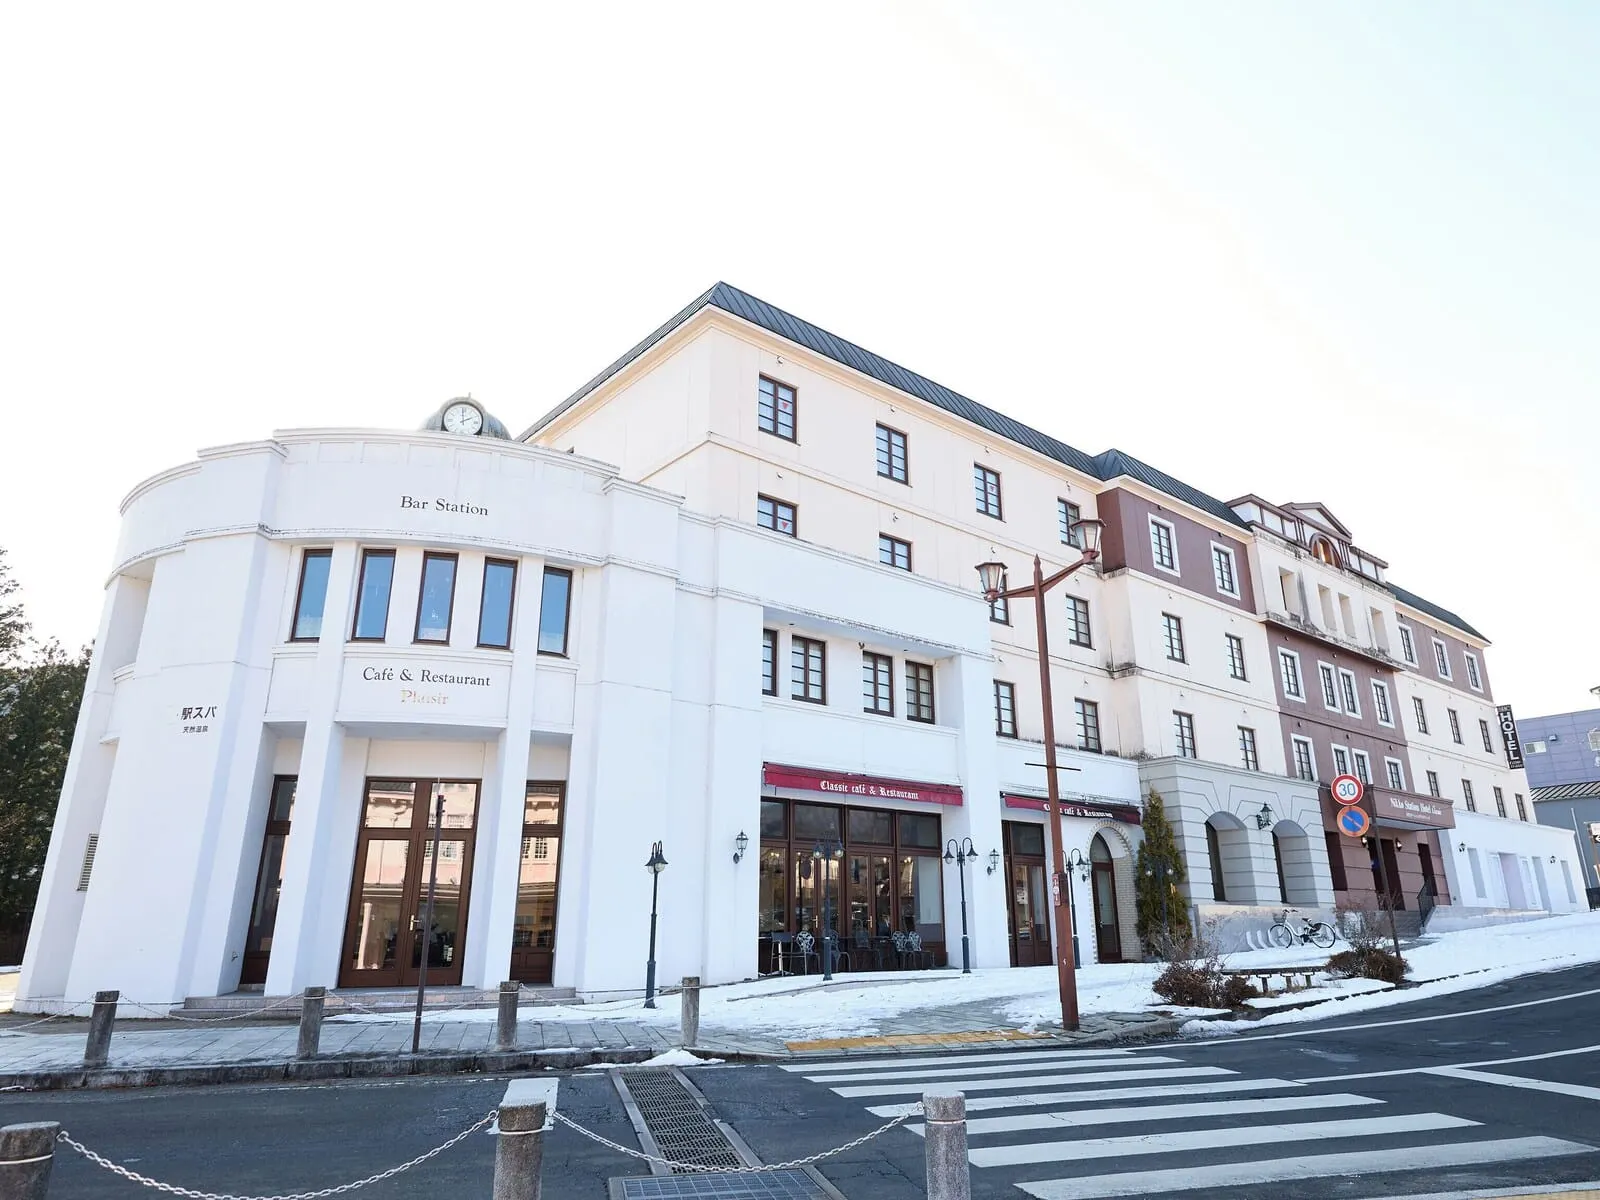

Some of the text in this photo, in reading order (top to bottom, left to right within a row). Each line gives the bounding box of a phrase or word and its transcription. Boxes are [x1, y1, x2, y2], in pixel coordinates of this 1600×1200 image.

[400, 496, 488, 516] Bar Station
[363, 667, 491, 686] Café & Restaurant
[180, 706, 217, 720] 駅スパ
[1500, 712, 1519, 760] HOTEL
[820, 780, 848, 792] Classic
[869, 786, 876, 795] &
[879, 786, 919, 800] Restaurant
[1338, 783, 1356, 797] 30
